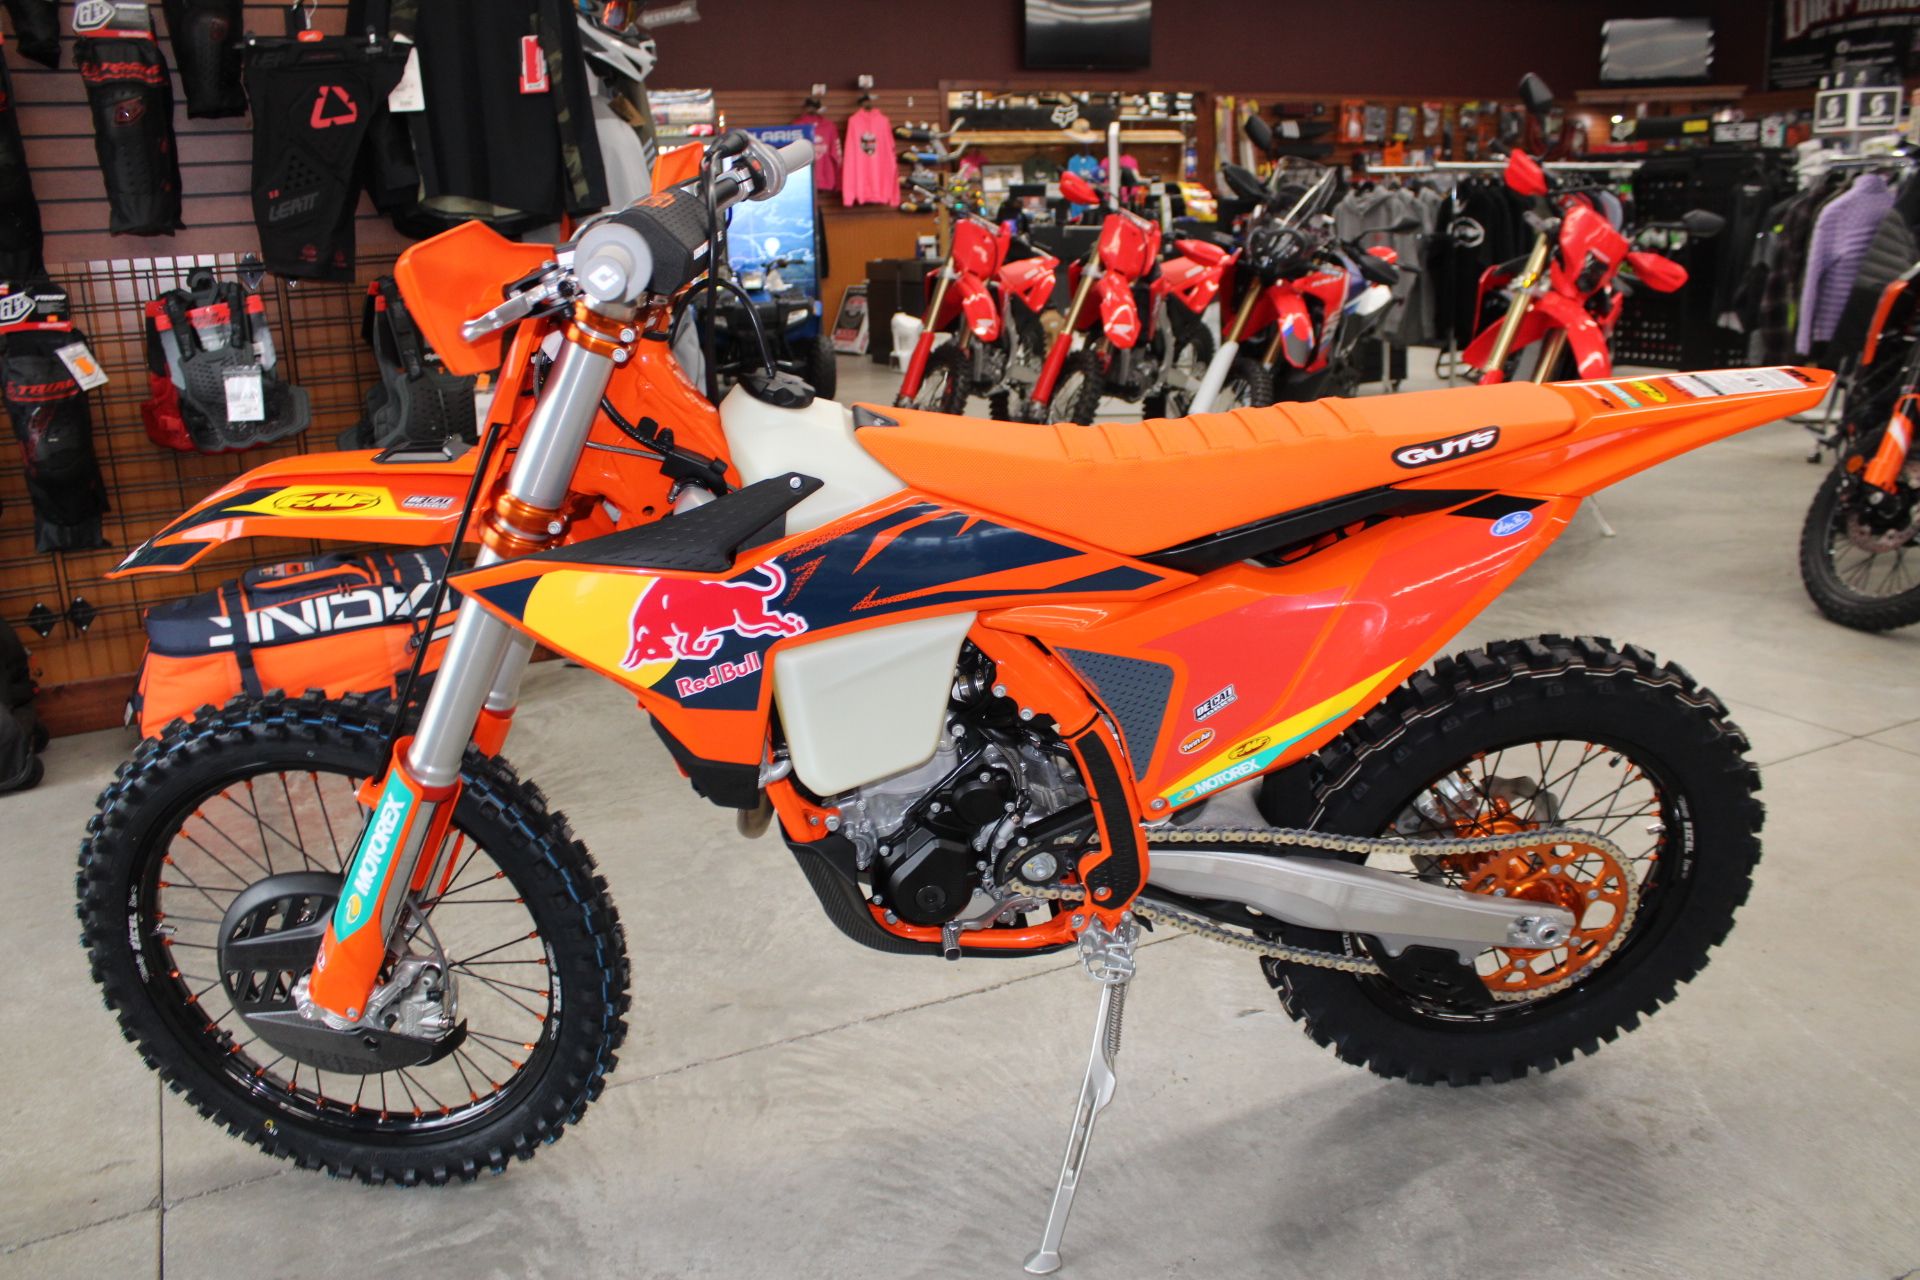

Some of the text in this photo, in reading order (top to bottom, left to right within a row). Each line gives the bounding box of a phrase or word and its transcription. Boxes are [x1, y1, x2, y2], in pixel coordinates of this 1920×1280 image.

[269, 192, 319, 222] LEATT
[1397, 429, 1497, 465] GUTS
[284, 491, 380, 511] FMF
[675, 651, 761, 698] Red Bull
[1182, 730, 1212, 752] Twin Air
[1194, 758, 1261, 795] MOTOREX
[353, 791, 406, 897] MOTOREX
